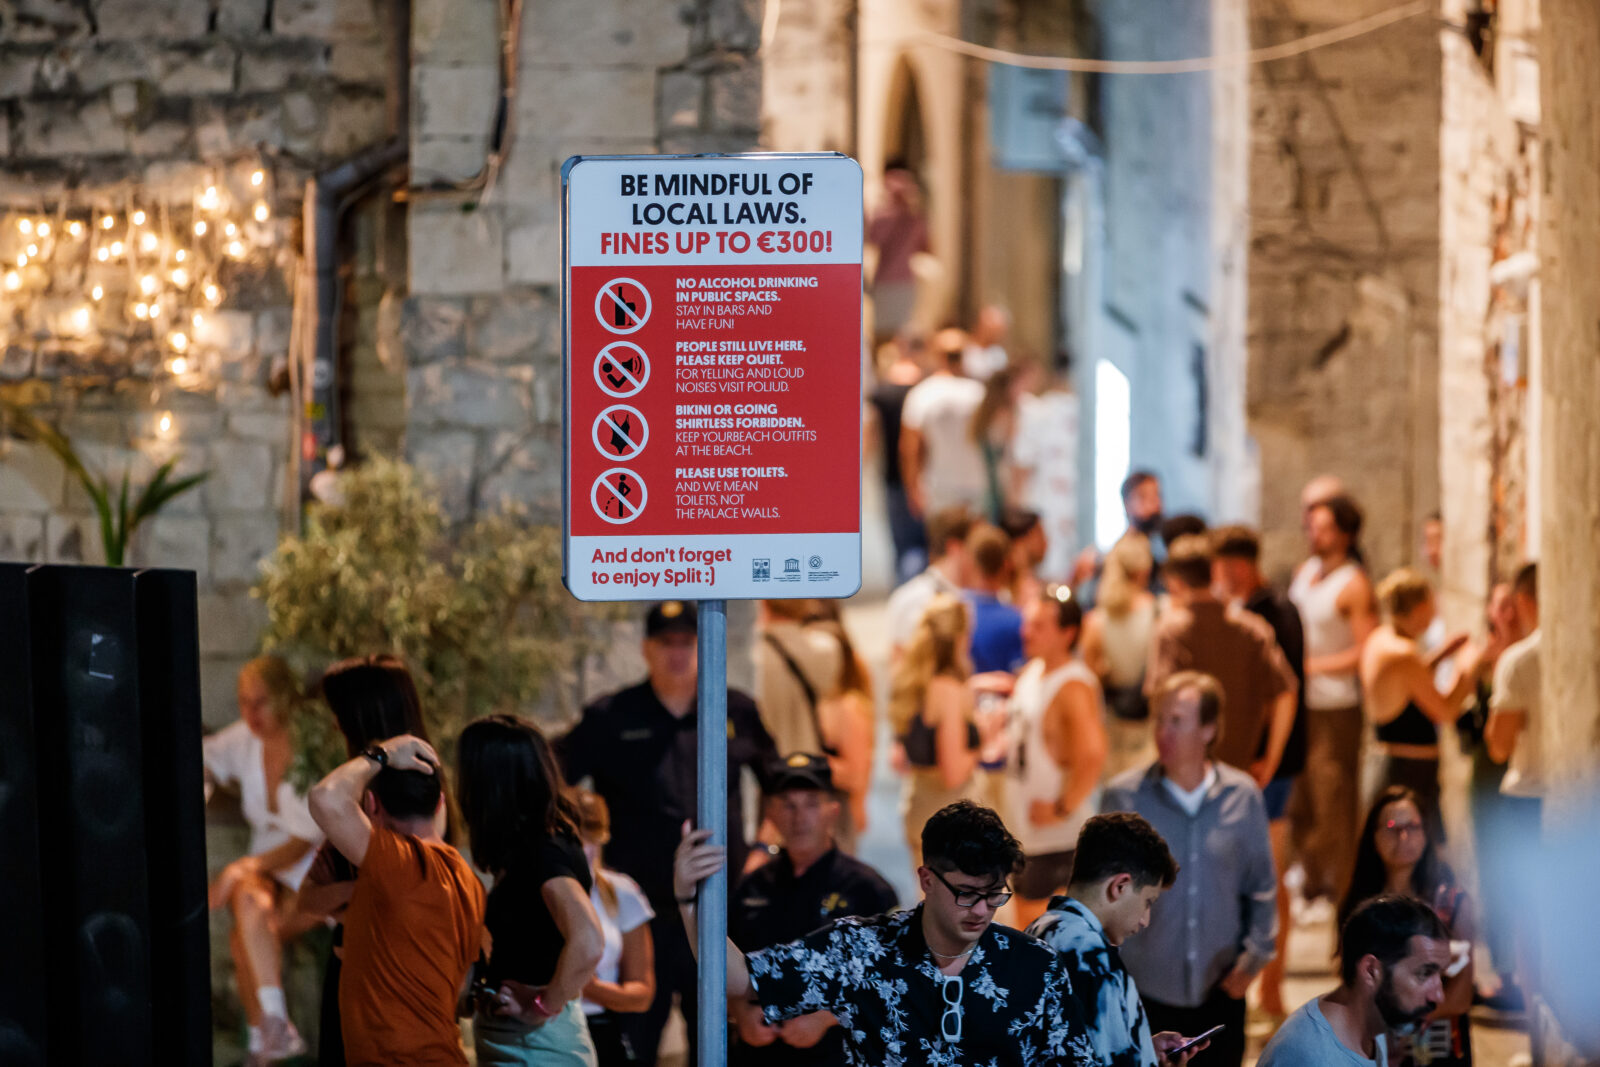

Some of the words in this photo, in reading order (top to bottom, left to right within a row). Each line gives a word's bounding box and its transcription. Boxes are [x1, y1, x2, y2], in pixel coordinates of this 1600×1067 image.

[621, 175, 648, 196] BE
[655, 174, 772, 196] MINDFUL
[778, 173, 813, 194] OF
[632, 203, 717, 225] LOCAL
[724, 202, 806, 224] LAWS.
[601, 232, 669, 254] FINES
[676, 232, 710, 254] UP
[716, 231, 750, 253] TO
[756, 230, 832, 253] €300!
[676, 278, 696, 288] NO
[698, 278, 756, 288] ALCOHOL
[759, 277, 818, 287] DRINKING
[676, 292, 689, 302] IN
[692, 292, 733, 302] PUBLIC
[735, 291, 781, 301] SPACES.
[676, 305, 701, 316] STAY
[703, 305, 715, 315] IN
[717, 305, 745, 315] BARS
[747, 305, 772, 315] AND
[676, 319, 706, 329] HAVE
[709, 319, 734, 329] FUN!
[676, 342, 718, 352] PEOPLE
[720, 341, 747, 351] STILL
[749, 341, 773, 351] LIVE
[775, 341, 806, 352] HERE,
[676, 355, 716, 365] PLEASE
[718, 355, 745, 365] KEEP
[747, 355, 783, 365] QUIET.
[676, 369, 699, 379] FOR
[701, 369, 744, 379] YELLING
[746, 368, 771, 378] AND
[774, 368, 804, 378] LOUD
[676, 383, 716, 392] NOISES
[718, 382, 745, 392] VISIT
[676, 405, 711, 415] BIKINI
[714, 405, 732, 415] OR
[734, 404, 777, 414] GOING
[676, 418, 734, 428] SHIRTLESS
[736, 418, 805, 428] FORBIDDEN.
[676, 432, 700, 442] KEEP
[772, 431, 816, 441] OUTFITS
[676, 446, 689, 456] AT
[691, 446, 711, 456] THE
[713, 445, 752, 455] BEACH.
[676, 468, 715, 478] PLEASE
[717, 468, 739, 477] USE
[741, 467, 788, 477] TOILETS.
[676, 482, 700, 492] AND
[703, 481, 721, 491] WE
[724, 481, 758, 491] MEAN
[676, 495, 718, 506] TOILETS,
[721, 495, 745, 505] NOT
[676, 509, 694, 519] THE
[698, 508, 738, 518] PALACE
[741, 507, 780, 518] WALLS.
[592, 548, 627, 564] And
[631, 548, 675, 563] don't
[679, 547, 732, 566] forget
[592, 573, 609, 584] to
[613, 570, 661, 587] enjoy
[664, 568, 702, 586] Split
